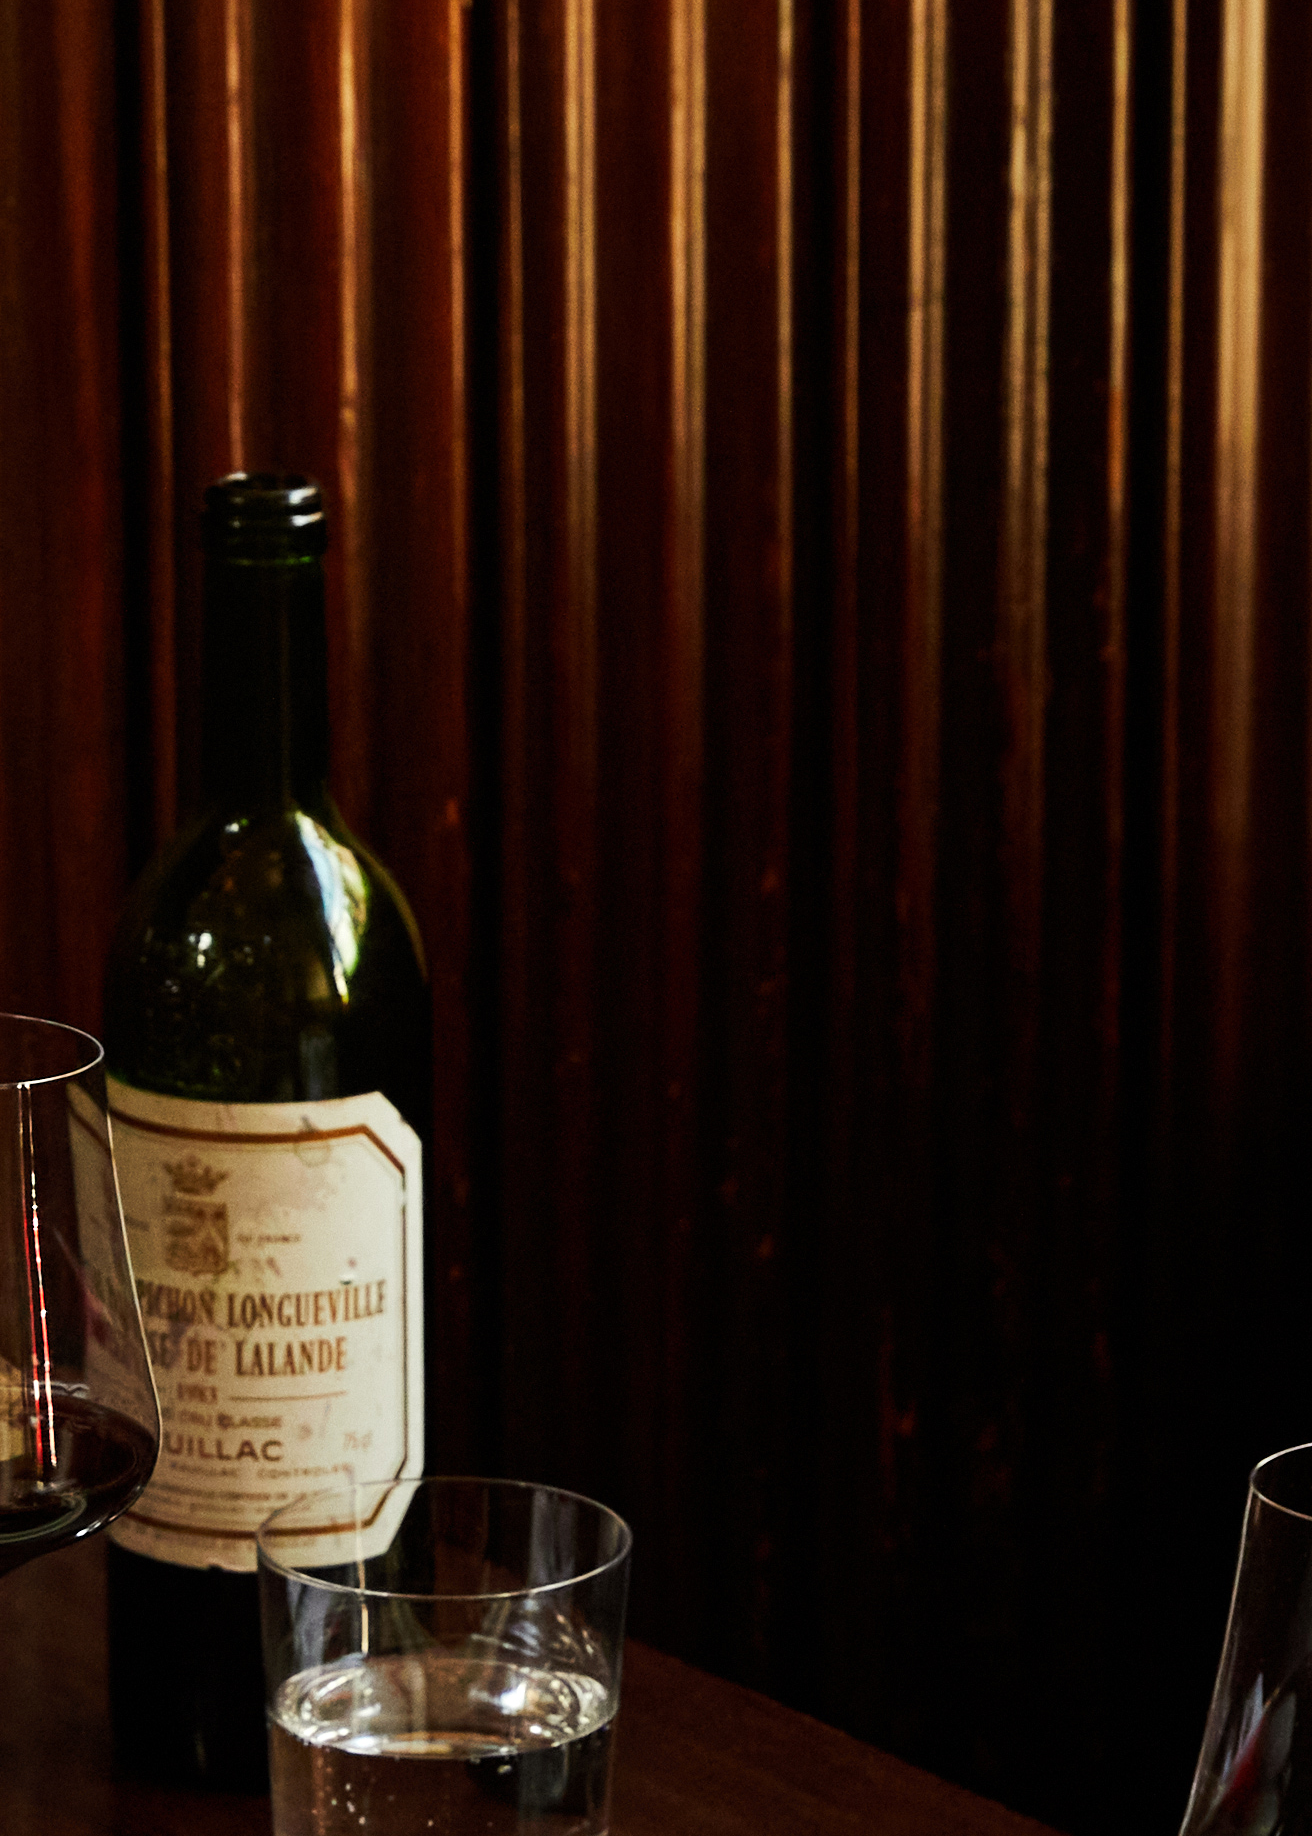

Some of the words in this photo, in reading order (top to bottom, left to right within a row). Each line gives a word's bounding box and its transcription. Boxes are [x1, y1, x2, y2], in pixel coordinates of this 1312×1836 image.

[227, 1279, 385, 1329] LONGUEVILLE
[187, 1337, 217, 1376] DE
[235, 1336, 347, 1377] LALANDE
[163, 1430, 283, 1462] UILLAC
